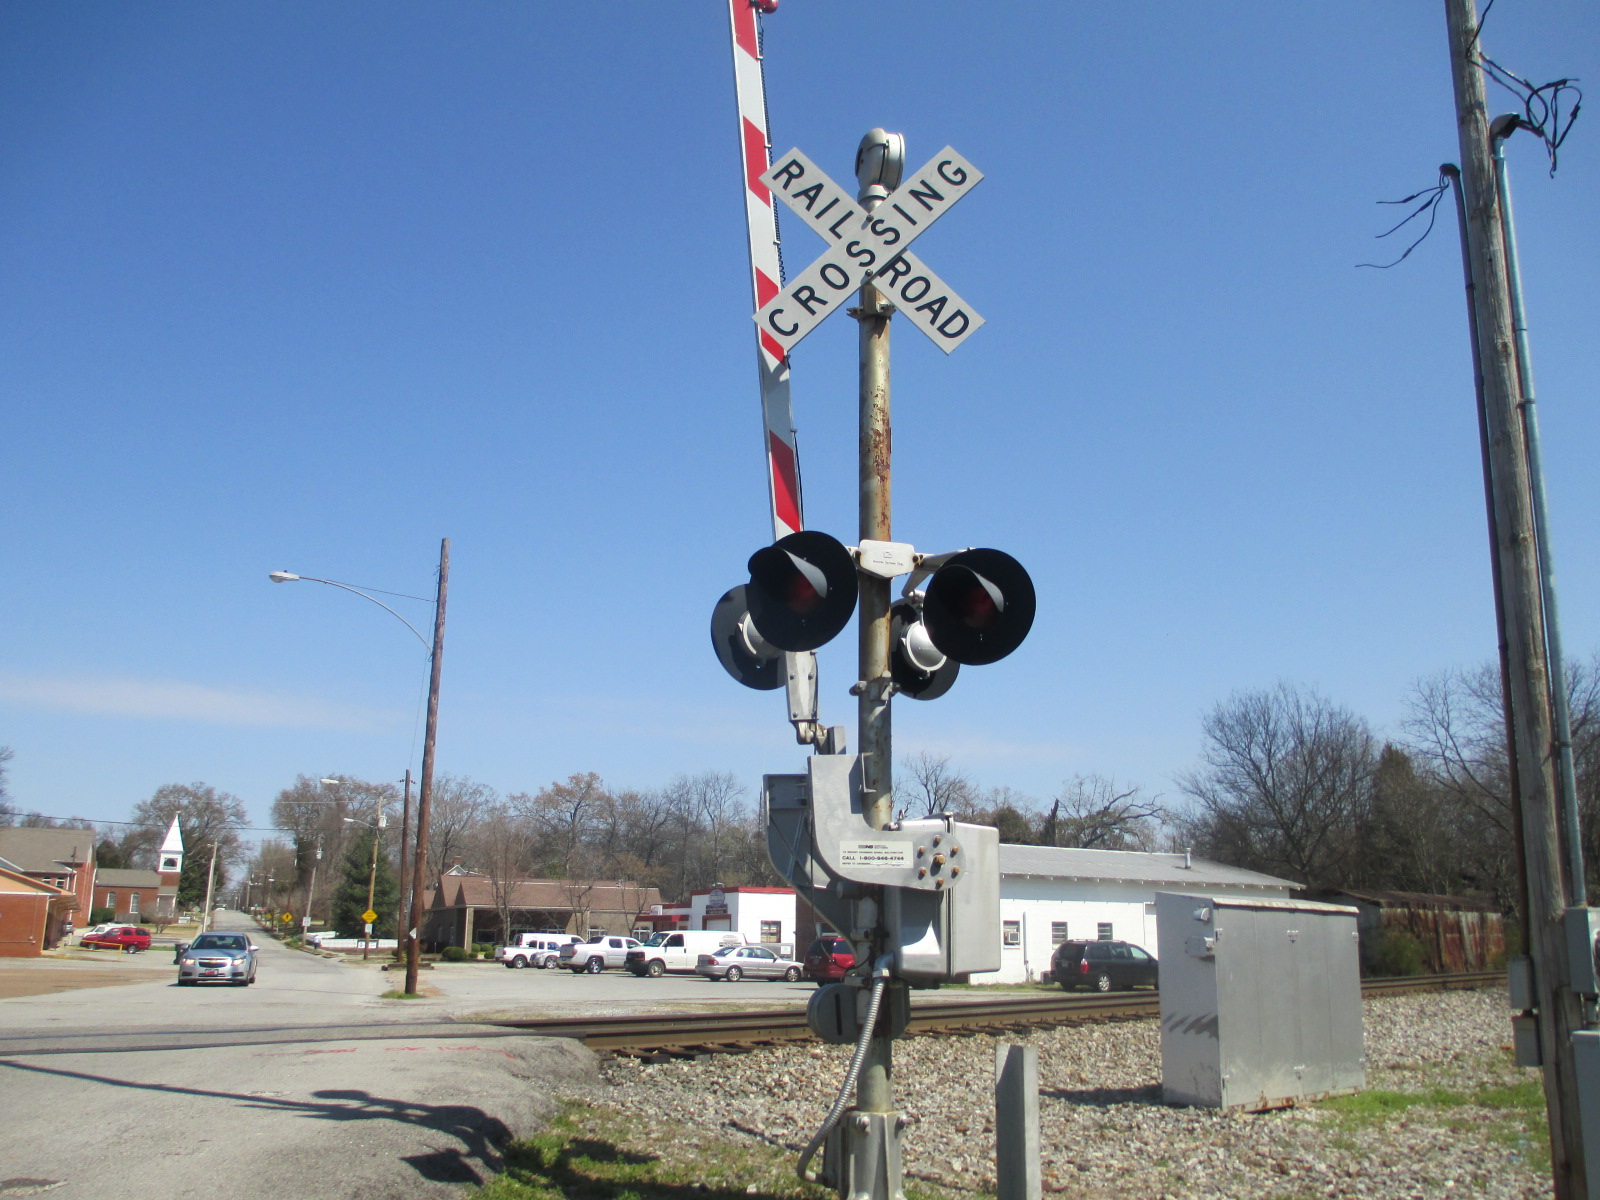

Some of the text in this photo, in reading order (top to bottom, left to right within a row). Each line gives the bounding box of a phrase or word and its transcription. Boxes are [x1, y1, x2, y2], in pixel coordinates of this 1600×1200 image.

[772, 158, 854, 240] RAIL
[768, 160, 967, 337] CROSSING
[877, 254, 970, 339] ROAD
